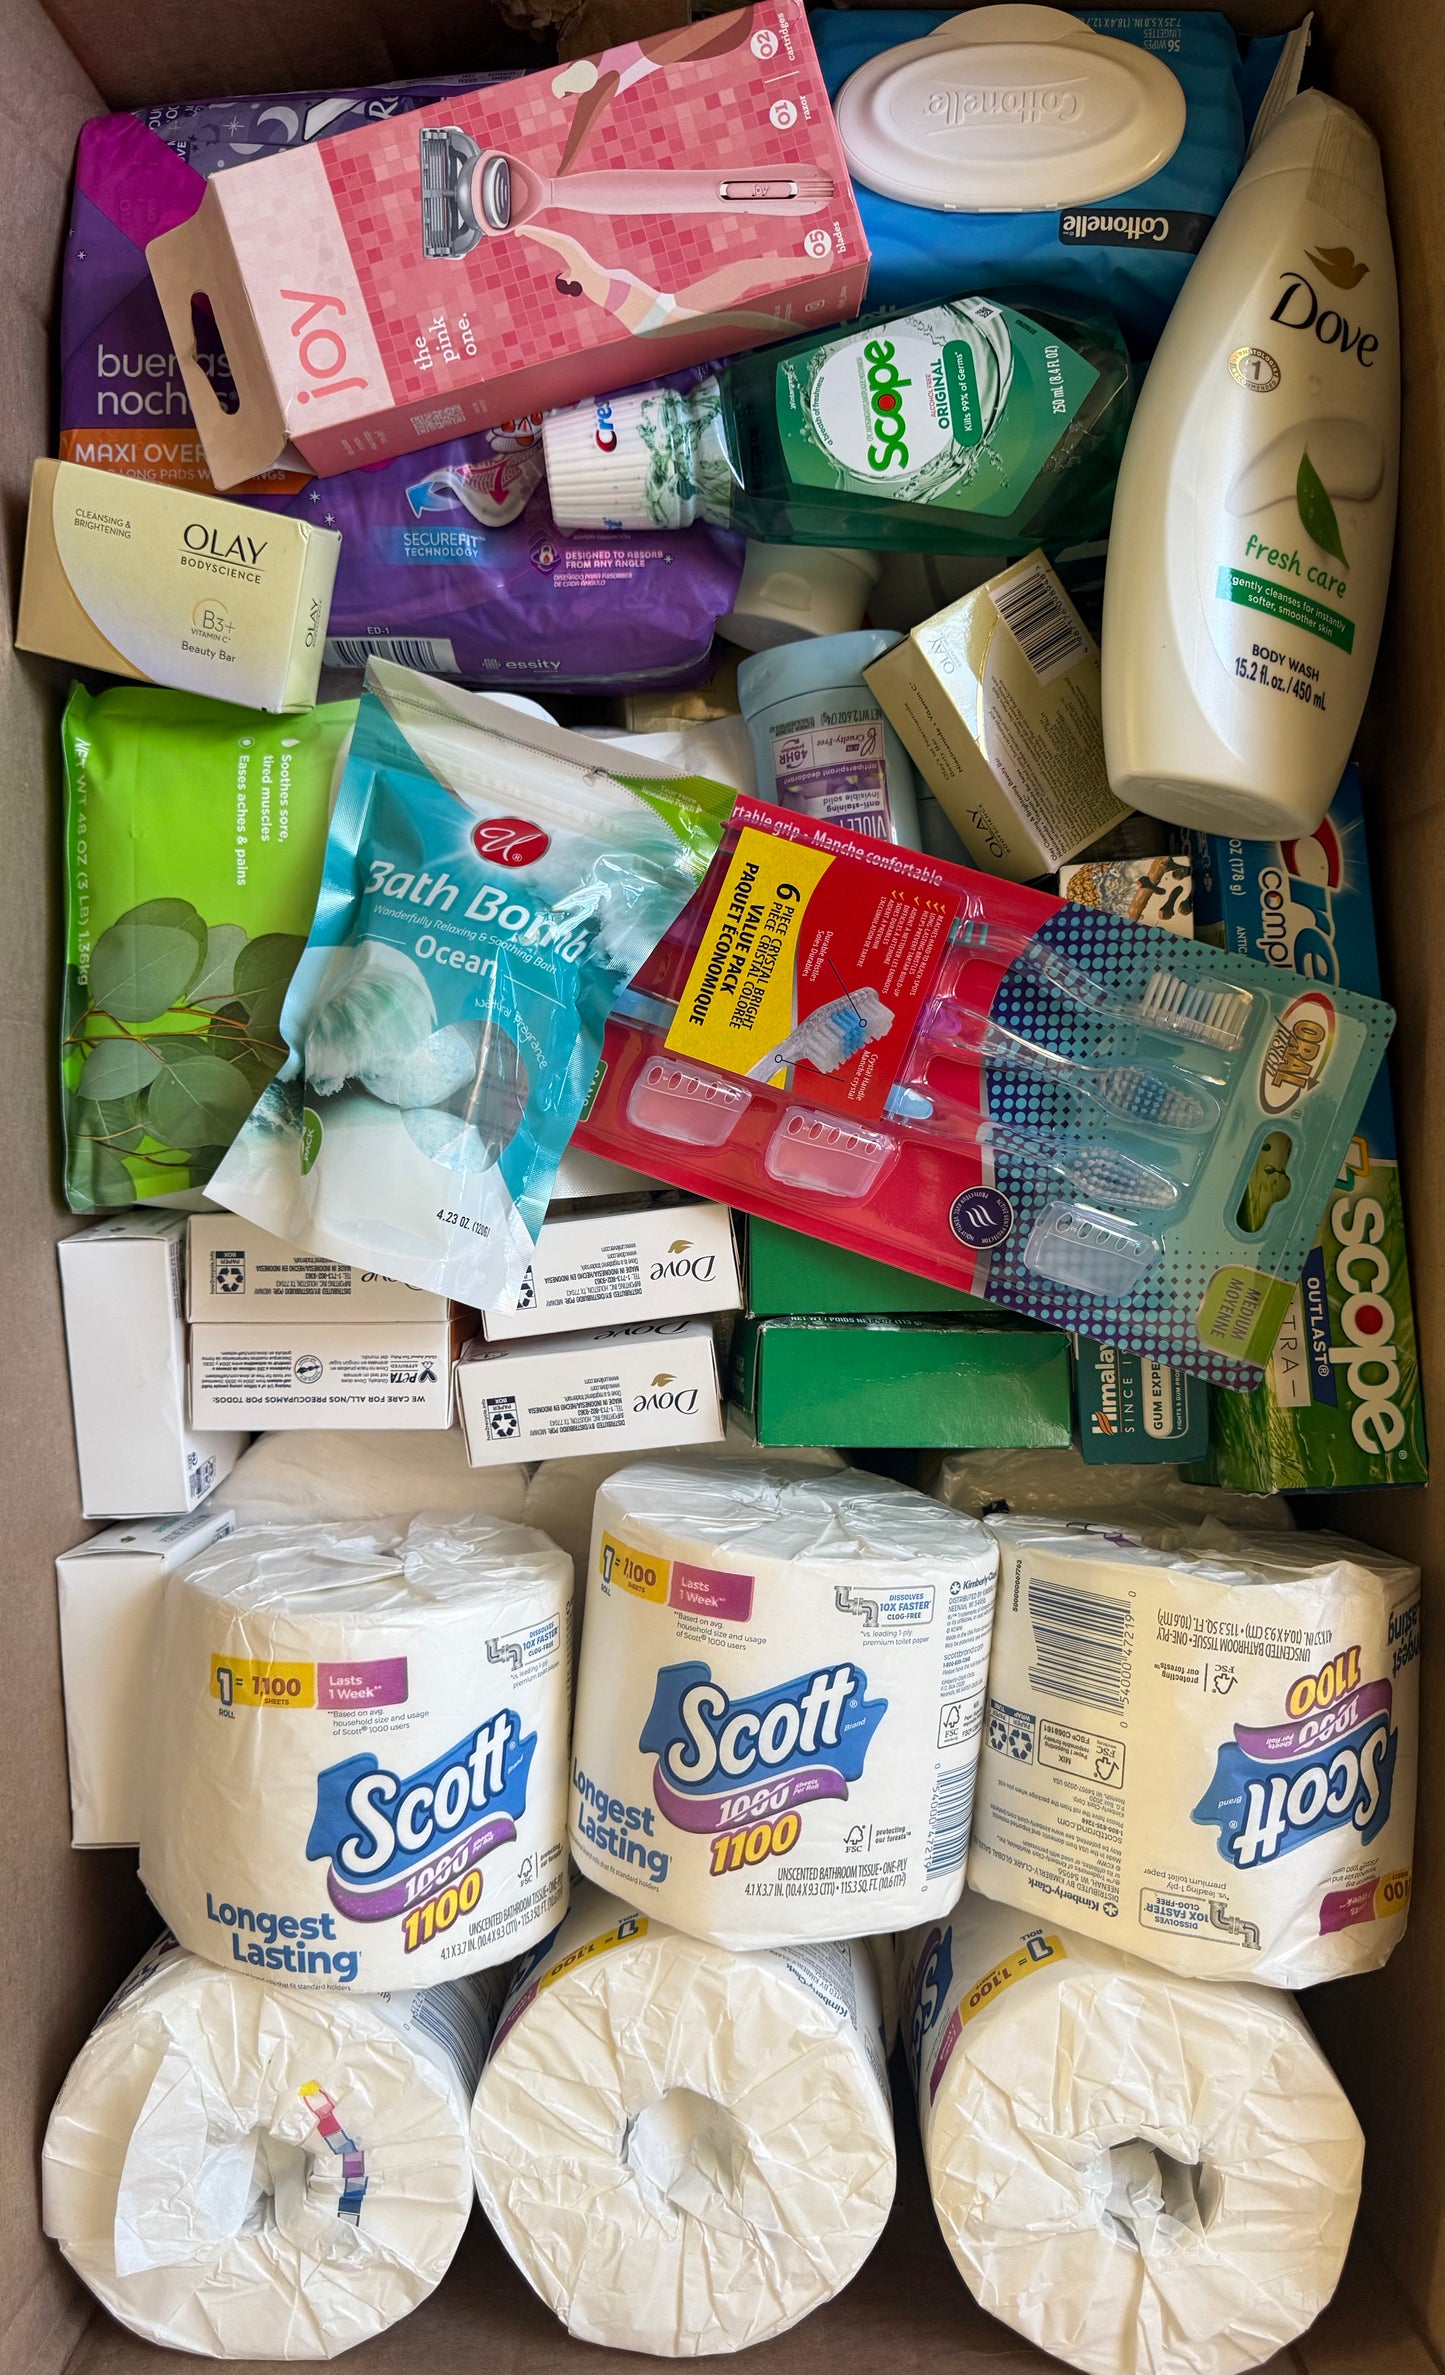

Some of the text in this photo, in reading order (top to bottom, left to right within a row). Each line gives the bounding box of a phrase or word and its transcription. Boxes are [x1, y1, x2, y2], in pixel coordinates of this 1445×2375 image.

[778, 12, 795, 60] cartridges
[800, 96, 811, 120] razor
[833, 221, 846, 254] blades
[1063, 214, 1169, 242] Cottonelle
[458, 312, 477, 356] one.
[1270, 272, 1378, 368] Dove
[280, 289, 368, 404] joy
[414, 336, 433, 370] the
[429, 316, 460, 363] pink
[930, 358, 950, 429] ORIGINAL
[1052, 398, 1066, 413] 250
[960, 392, 972, 431] Kills 99%
[75, 443, 136, 463] MAXI
[74, 518, 132, 539] BRIGHTENING
[75, 509, 124, 528] CLEANSING
[183, 524, 268, 565] OLAY
[405, 548, 479, 558] TECHNOLOGY
[565, 550, 664, 560] DESIGNED ABSORB
[180, 556, 262, 584] BODYSCIENCE
[566, 559, 646, 569] FROM ANGLE
[1245, 535, 1346, 598] fresh care
[1232, 575, 1346, 632] gently cleanses for instantly
[1248, 594, 1333, 637] softer, smoother skin
[191, 628, 221, 642] VITAMIN
[305, 598, 319, 648] OLAY
[182, 641, 236, 663] Beauty Bar
[505, 659, 560, 671] essity
[1252, 644, 1319, 682] BODY WASH
[1235, 657, 1311, 703] 15.2 450
[816, 734, 864, 746] Cruelty-Free
[779, 749, 807, 764] 48HR
[783, 762, 876, 784] antiperspirant deodorant
[261, 755, 274, 842] tired muscles
[278, 754, 292, 843] Soothes sore,
[822, 791, 879, 804] invisible solid
[826, 800, 879, 812] anti-staining
[235, 755, 249, 886] Eases aches pains
[965, 805, 1006, 860] OLAY
[772, 820, 943, 887] grip Manche confortable
[1229, 858, 1245, 881] (178
[363, 860, 461, 911] Bath
[373, 903, 558, 974] Wonderfully Relaxing Bath
[687, 860, 759, 1028] PAQUET ÉCONOMIQUE
[719, 901, 765, 995] VALUE PACK
[76, 931, 90, 985] 1.36kg
[415, 933, 499, 978] Ocean
[740, 881, 803, 1031] 6 PIECE CRYSTAL BRIGHT
[746, 933, 771, 980] CRISTAL
[1270, 1015, 1327, 1095] ORAL
[437, 1209, 459, 1225] 4.23
[649, 1255, 717, 1282] Dove
[1209, 1277, 1244, 1340] MOYENNE
[1232, 1287, 1263, 1342] MEDIUM
[1329, 1197, 1405, 1454] scope
[264, 1395, 326, 1403] PREOCUPAMOS
[328, 1395, 365, 1403] ALL/NOS
[633, 1389, 699, 1415] Dove
[1122, 1377, 1135, 1433] SINCE
[1153, 1401, 1163, 1430] GUM
[681, 1577, 710, 1592] Lasts
[889, 1593, 924, 1601] DISSOLVES
[880, 1602, 896, 1611] 10X
[887, 1612, 921, 1620] CLOG-FREE
[529, 1621, 555, 1638] DISSOLVES
[677, 1621, 712, 1635] household
[527, 1641, 555, 1657] CLOG-FREE
[1156, 1628, 1310, 1662] UNSCENTED BATHROOM ONE-PLY
[329, 1676, 362, 1686] Lasts
[1162, 1671, 1199, 1683] protecting
[1214, 1664, 1234, 1674] FSC
[1286, 1645, 1362, 1719] 1100
[219, 1708, 235, 1719] ROLL
[333, 1718, 373, 1727] household
[665, 1667, 856, 1782] Scott
[844, 1718, 867, 1733] Brand
[1095, 1744, 1116, 1757] FSC
[339, 1708, 512, 1875] Scott
[573, 1757, 655, 1837] Longest
[1218, 1796, 1242, 1808] Brand
[1229, 1726, 1394, 1869] Scott
[709, 1810, 803, 1877] 1100
[876, 1826, 906, 1835] protecting
[1054, 1816, 1123, 1844] scottbrand.com
[845, 1845, 863, 1853] FSC
[778, 1858, 907, 1881] UNSCENTED BATHROOM TISSUE ONE-PLY
[1188, 1877, 1227, 1890] premium
[1028, 1876, 1099, 1914] Kimberly-Clark
[1156, 1897, 1200, 1910] CLOG-FREE
[206, 1892, 335, 1943] Longest
[402, 1868, 483, 1954] 1100
[1154, 1915, 1198, 1930] DISSOLVES
[1020, 1929, 1043, 1941] ROLL
[787, 1962, 847, 2017] Kimberly-Clark
